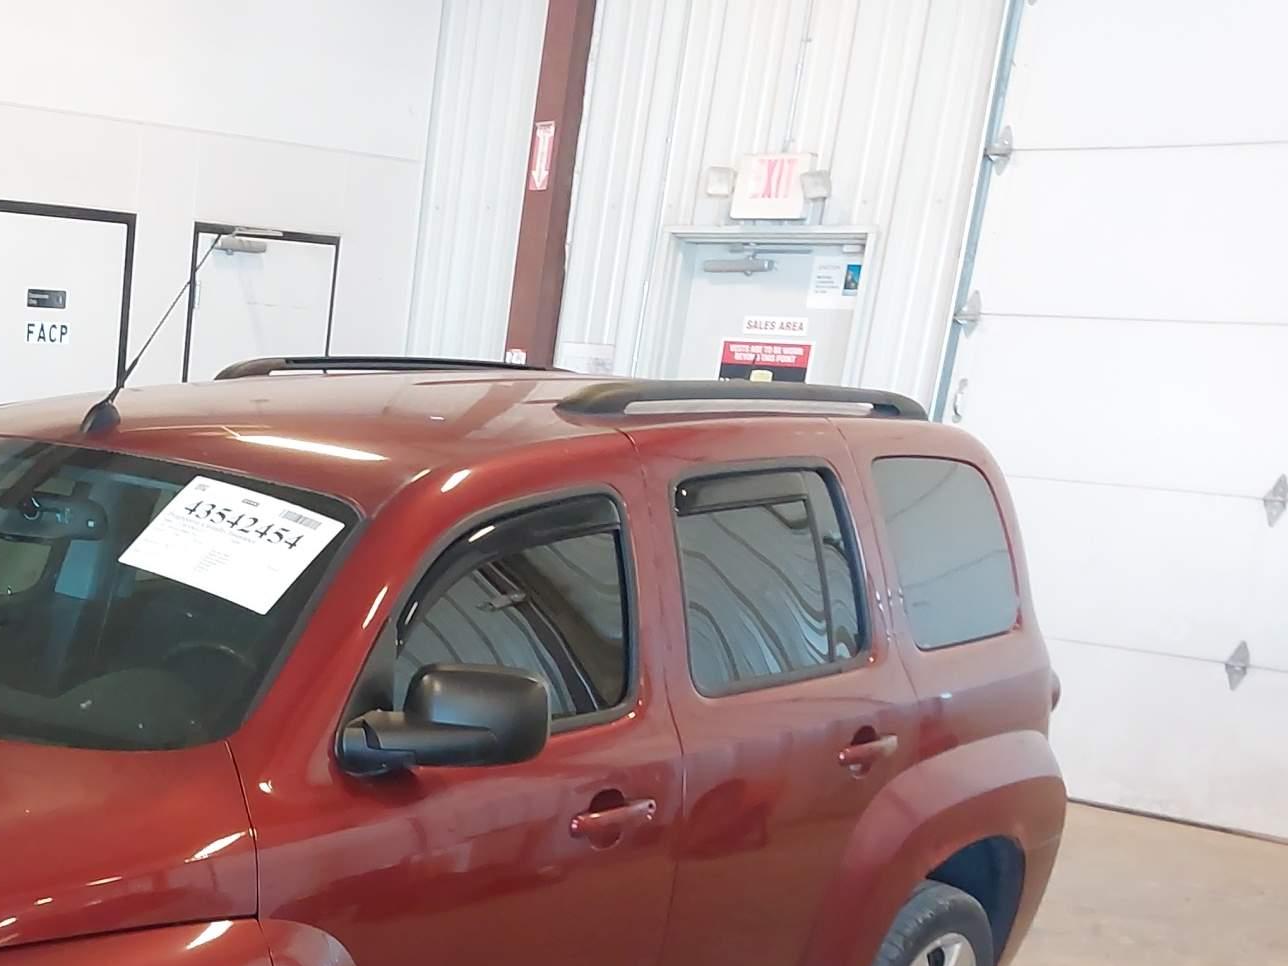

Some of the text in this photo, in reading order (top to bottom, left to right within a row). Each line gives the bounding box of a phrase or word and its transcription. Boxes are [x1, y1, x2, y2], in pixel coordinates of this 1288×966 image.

[26, 322, 68, 344] FACP
[746, 319, 804, 331] SALES AREA
[184, 500, 305, 550] 43542454
